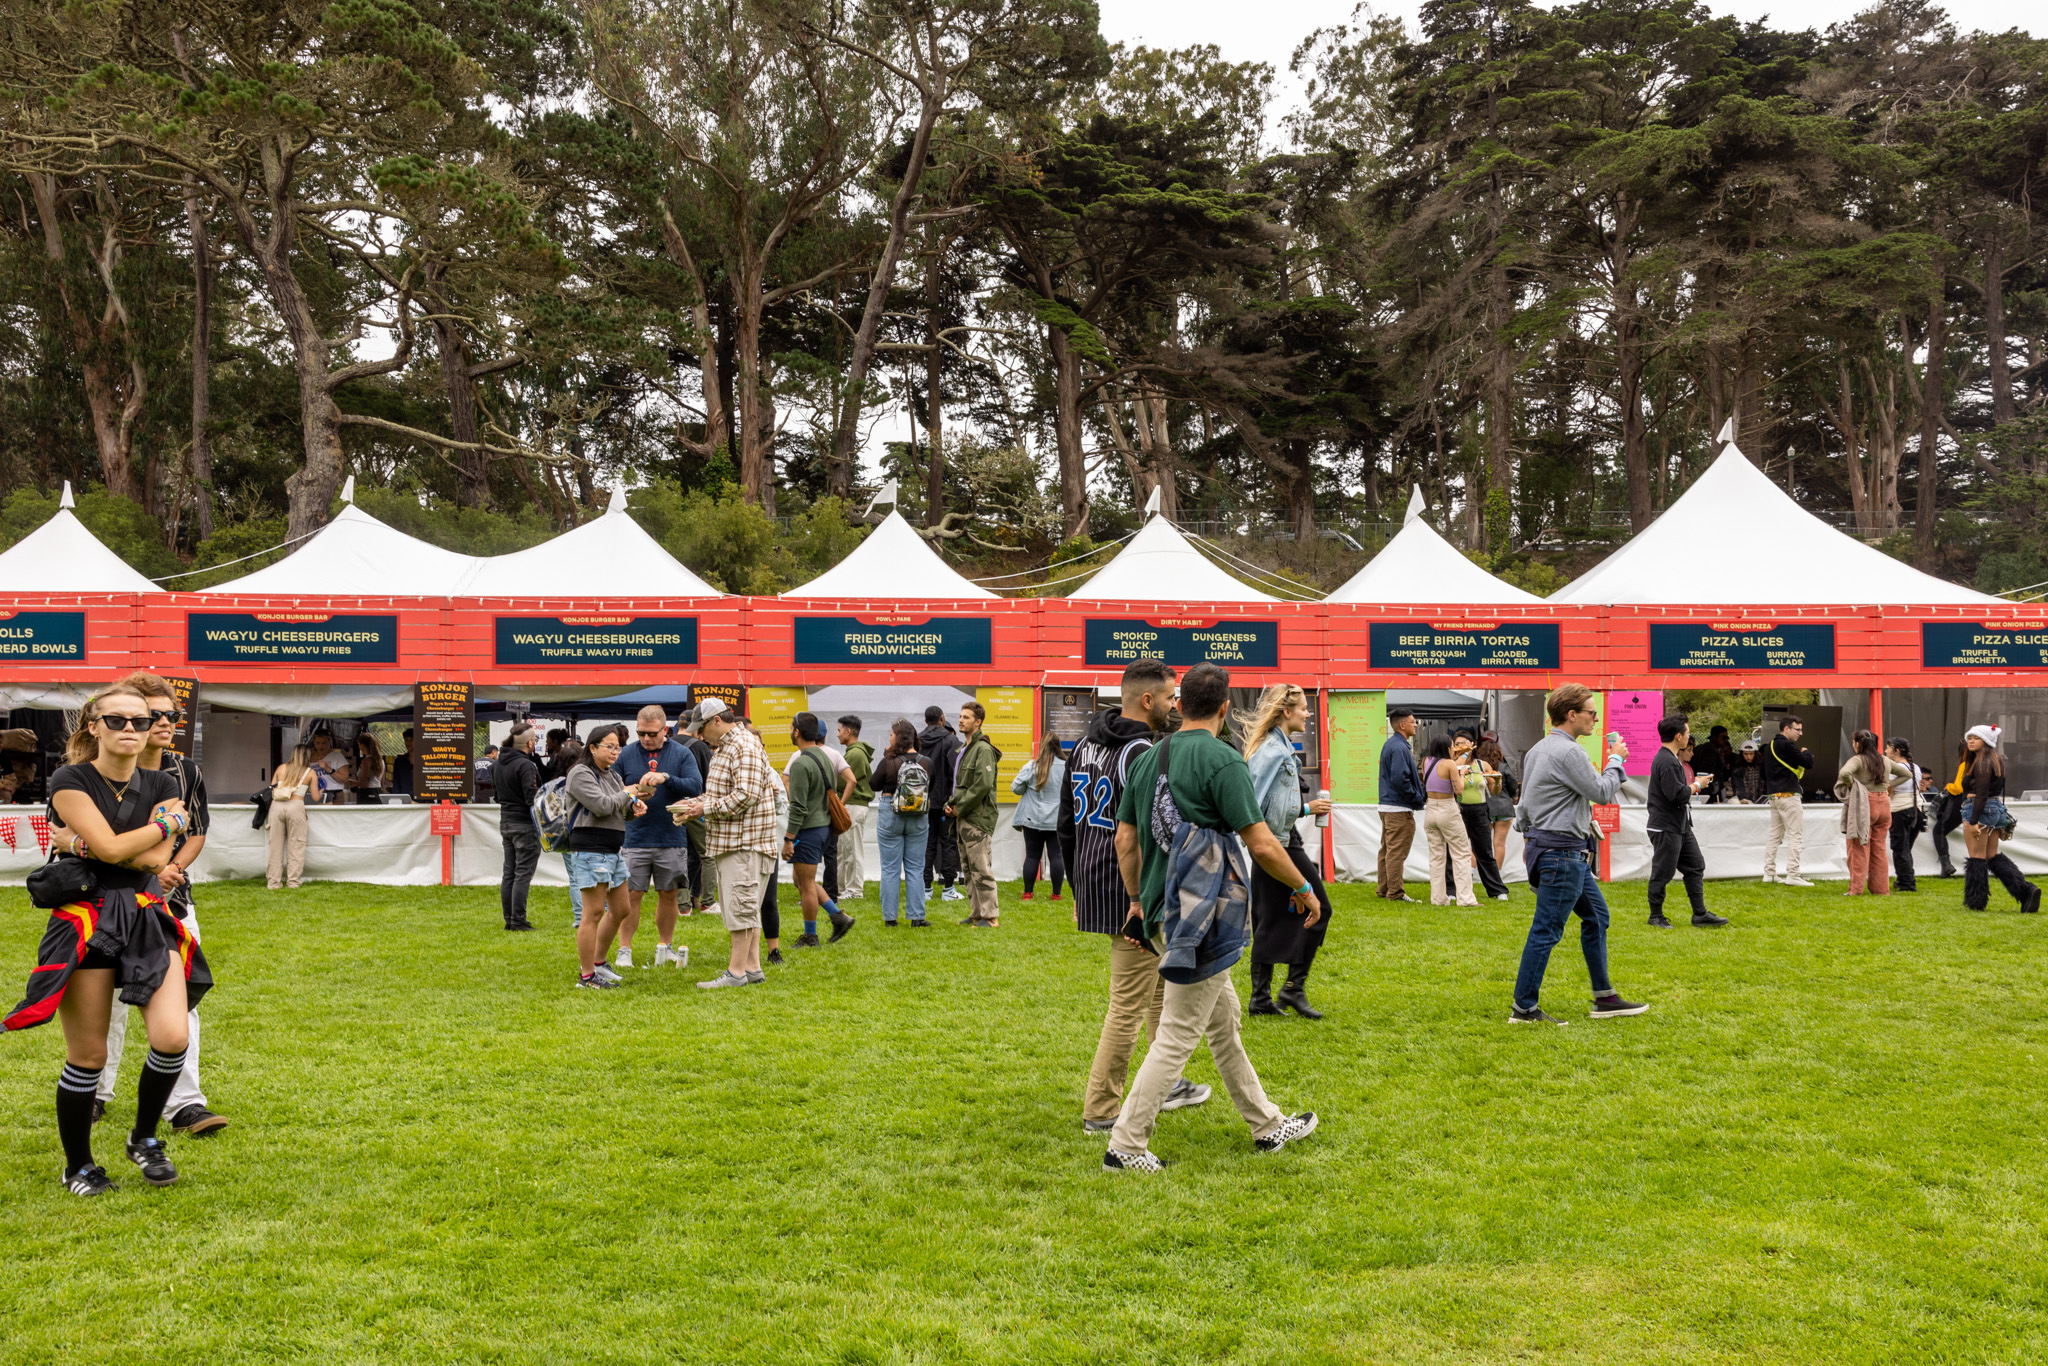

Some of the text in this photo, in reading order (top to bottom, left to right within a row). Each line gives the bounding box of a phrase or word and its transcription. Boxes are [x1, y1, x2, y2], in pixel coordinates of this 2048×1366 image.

[206, 631, 379, 642] WAGYU CHEESEBURGERS
[513, 635, 680, 644] WAGYU CHEESEBURGERS
[845, 634, 942, 643] FRIED CHICKEN
[1113, 632, 1158, 640] SMOKED
[1193, 633, 1256, 641] DUNGENESS
[1400, 636, 1529, 645] BEEF BIRRIA TORTAS
[1973, 636, 2011, 644] PIZZA
[1121, 641, 1149, 649] DUCK
[1702, 637, 1783, 646] PIZZA SLICES
[32, 644, 77, 654] BOWLS
[851, 645, 936, 654] SANDWICHES
[1107, 650, 1137, 658] FRIED
[421, 684, 468, 693] KONJOE
[693, 686, 740, 696] KONJOE
[422, 692, 466, 702] BURGER
[1998, 689, 2048, 699] TIMELES
[1346, 696, 1370, 704] Menu
[1071, 772, 1115, 830] 32
